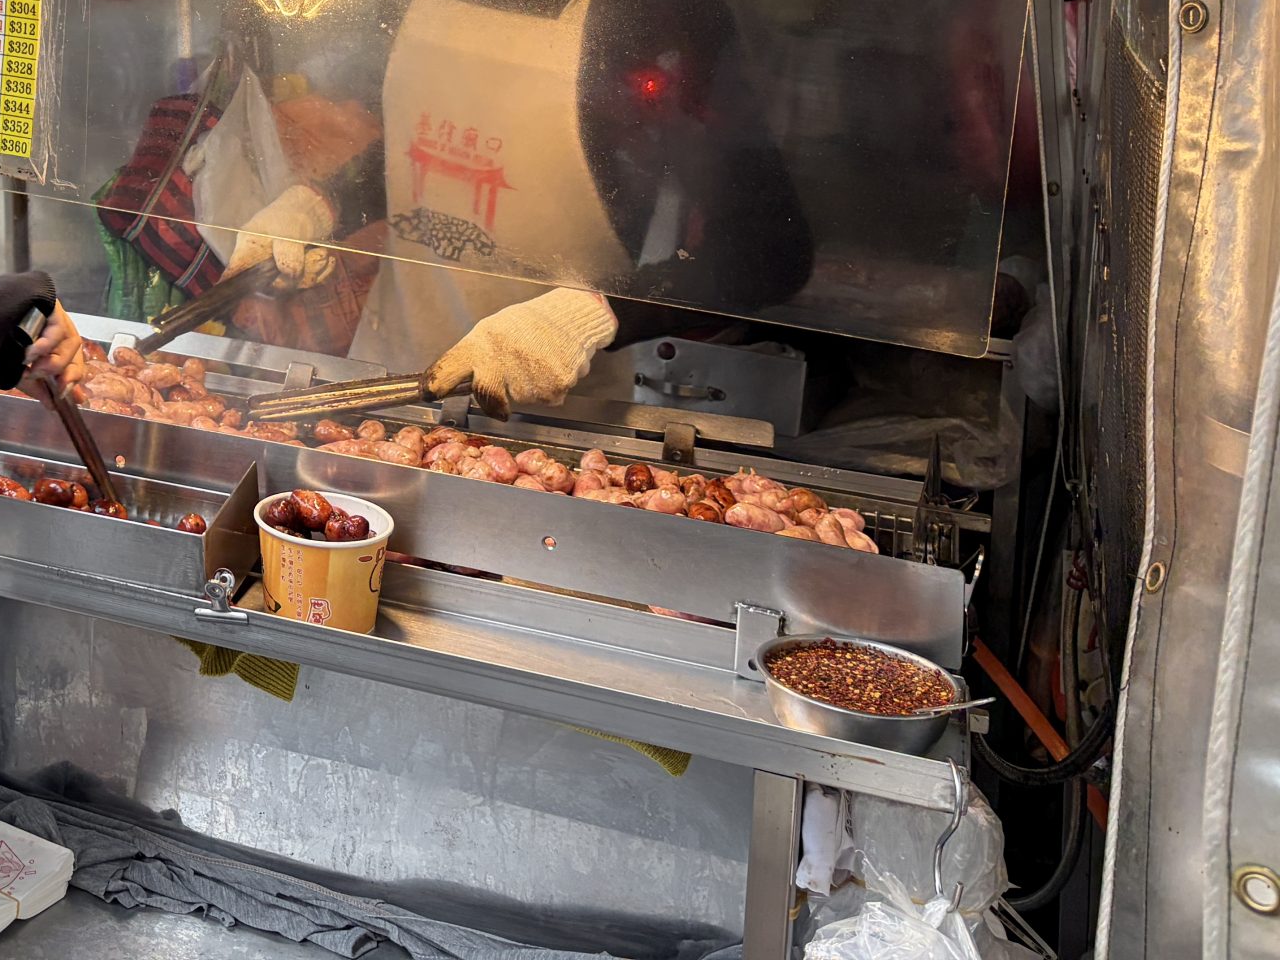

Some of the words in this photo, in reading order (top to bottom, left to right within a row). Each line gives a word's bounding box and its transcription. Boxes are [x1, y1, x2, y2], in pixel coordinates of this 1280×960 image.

[9, 0, 36, 15] $304
[7, 19, 35, 35] $312
[6, 38, 33, 55] $320
[5, 58, 32, 75] $328
[3, 78, 31, 94] $336
[2, 98, 30, 114] $344
[1, 118, 28, 134] $352
[0, 137, 27, 154] $360
